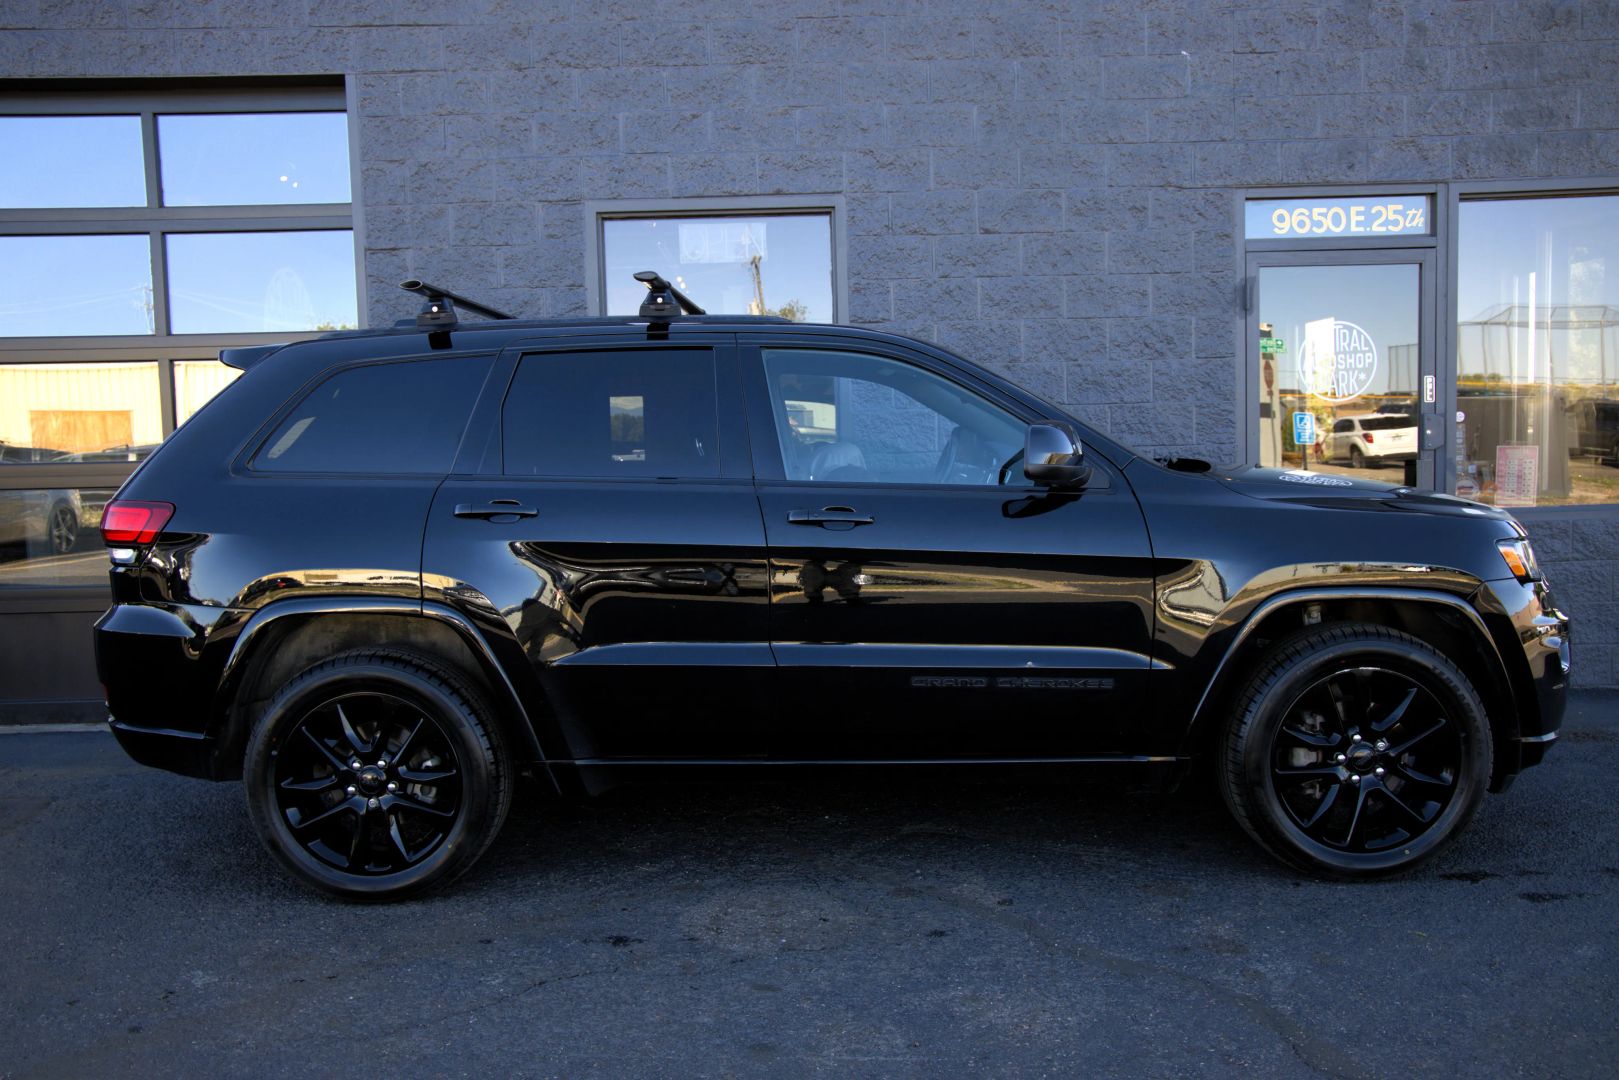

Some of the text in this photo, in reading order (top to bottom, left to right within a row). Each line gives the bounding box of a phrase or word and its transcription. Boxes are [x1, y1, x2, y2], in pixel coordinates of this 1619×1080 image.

[1271, 206, 1347, 235] 9650
[1327, 370, 1359, 398] ARK
[911, 676, 1114, 688] GRAND CHEROKEE
